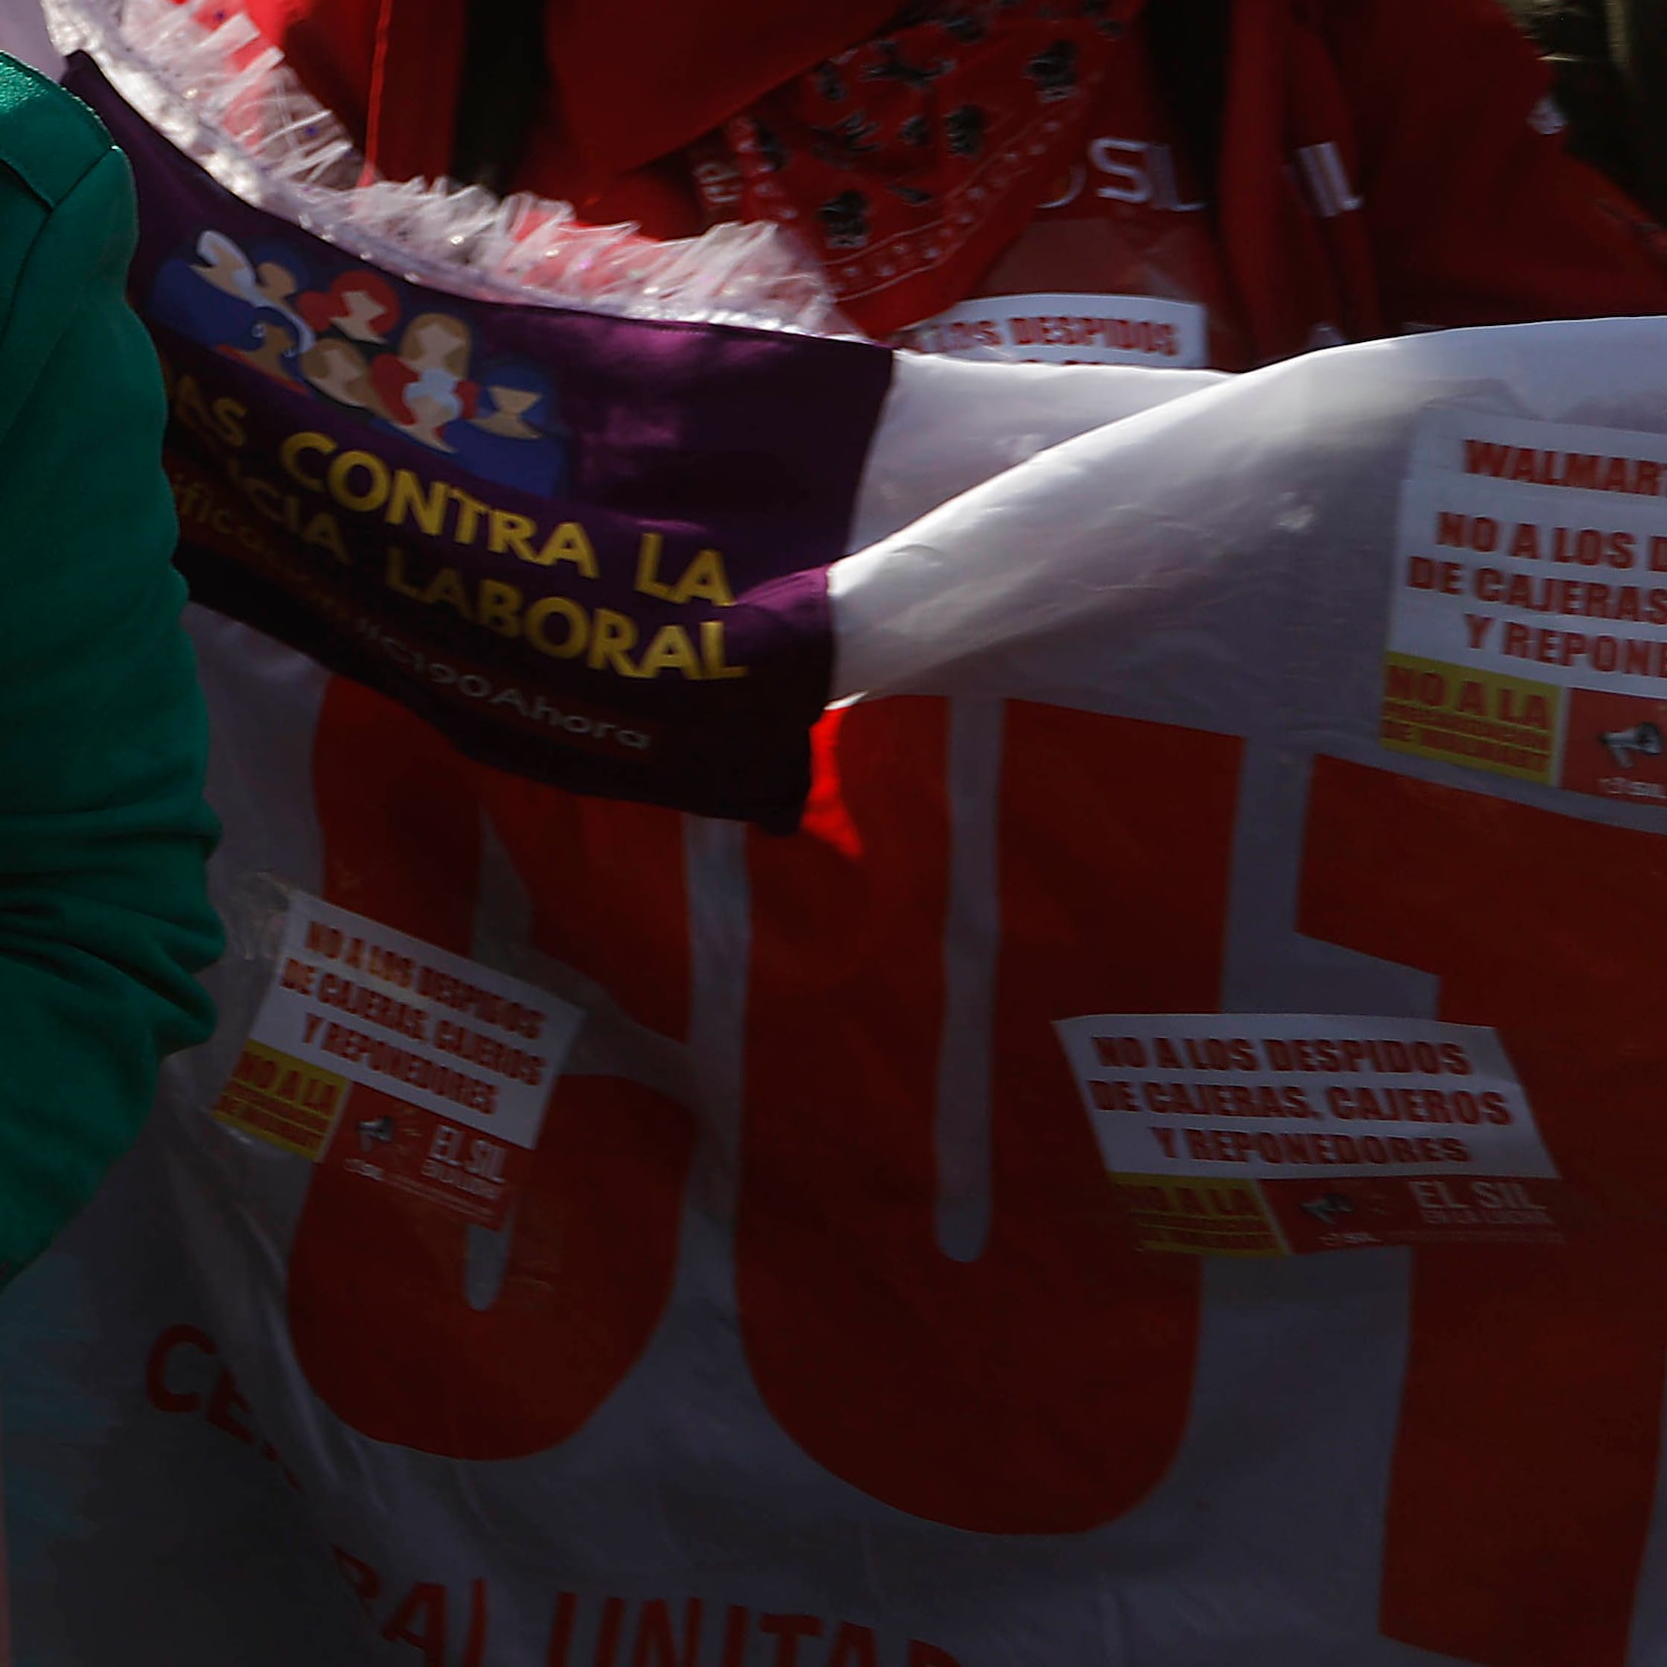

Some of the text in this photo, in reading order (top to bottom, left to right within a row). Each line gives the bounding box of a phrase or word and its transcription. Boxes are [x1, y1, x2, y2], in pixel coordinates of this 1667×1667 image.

[1463, 438, 1667, 497] WALMAR
[278, 430, 601, 583] CONTRA
[634, 531, 738, 608] LA
[1435, 510, 1499, 553] NO
[1509, 522, 1541, 560] A
[1551, 526, 1635, 571] LOS
[1405, 555, 1464, 596] DE
[380, 543, 750, 683] LABORAL
[1464, 613, 1496, 650] Y
[1456, 680, 1487, 716] A
[301, 1012, 325, 1044] Y
[1090, 1035, 1474, 1076] NO A LOS DESPIDOS
[1085, 1079, 1140, 1113] DE
[1325, 1086, 1514, 1127] CAJEROS
[1149, 1125, 1473, 1166] Y REPONEDORES
[1409, 1180, 1549, 1211] EL SIL
